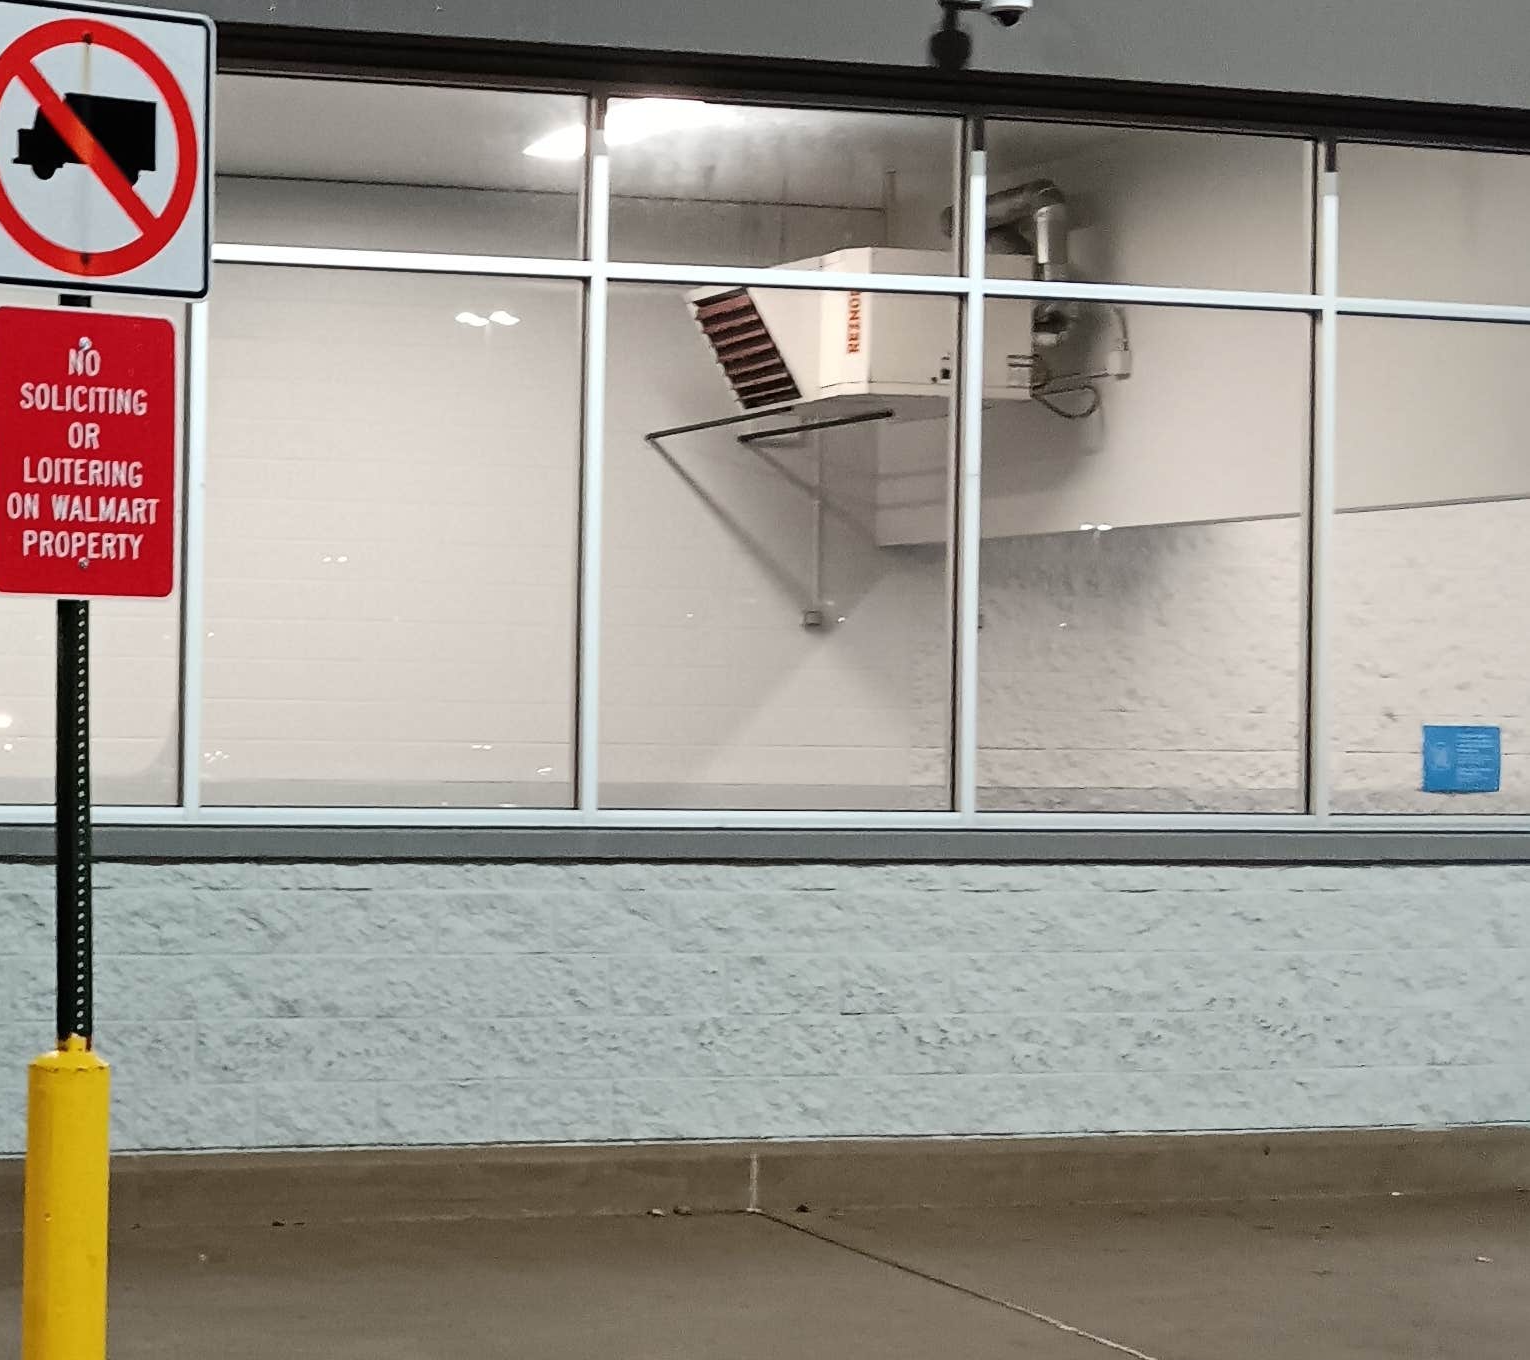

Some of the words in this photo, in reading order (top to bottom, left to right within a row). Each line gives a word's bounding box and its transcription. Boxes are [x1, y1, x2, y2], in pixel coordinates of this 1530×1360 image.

[68, 348, 101, 377] NO
[19, 382, 148, 416] SOLICITING
[68, 421, 100, 449] OR
[23, 456, 143, 488] LOITERING
[6, 492, 40, 520] ON
[51, 493, 160, 525] WALMART
[22, 529, 144, 560] PROPERTY
